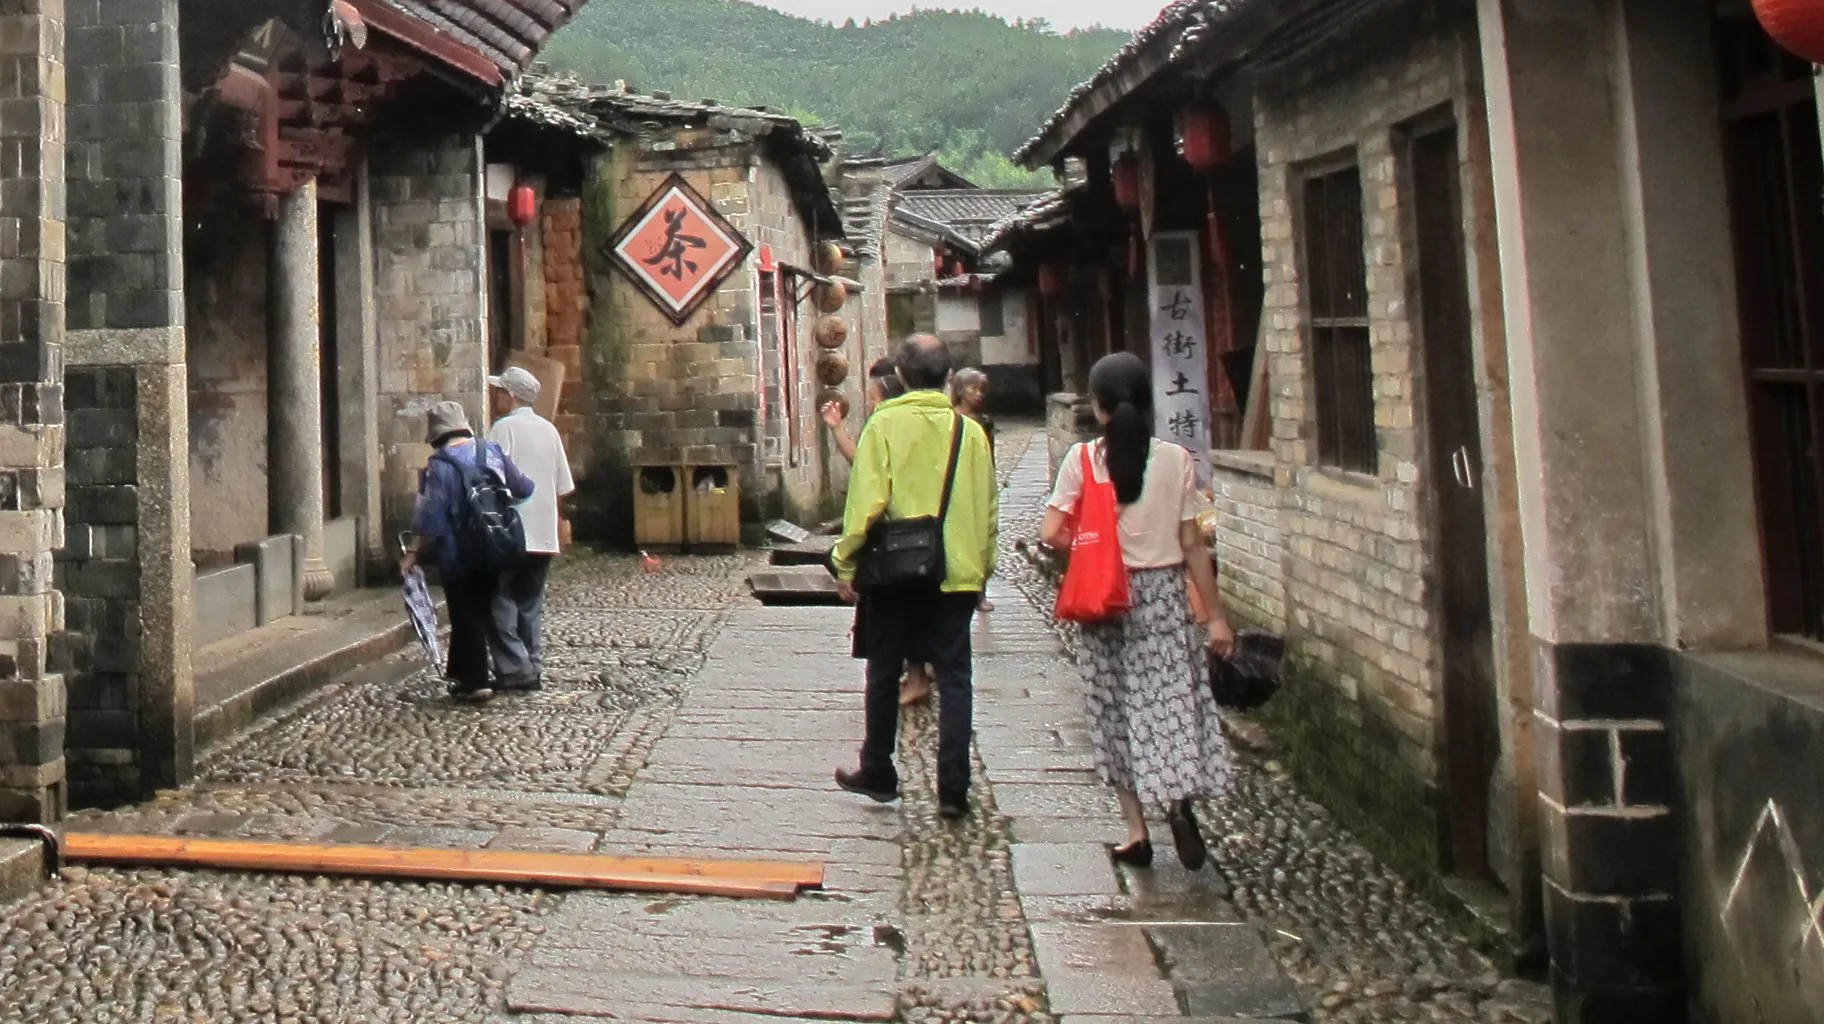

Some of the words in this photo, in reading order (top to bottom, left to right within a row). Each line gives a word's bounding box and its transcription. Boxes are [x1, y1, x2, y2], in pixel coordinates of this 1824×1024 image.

[642, 207, 706, 281] 茶
[1160, 292, 1200, 463] 古街土特
